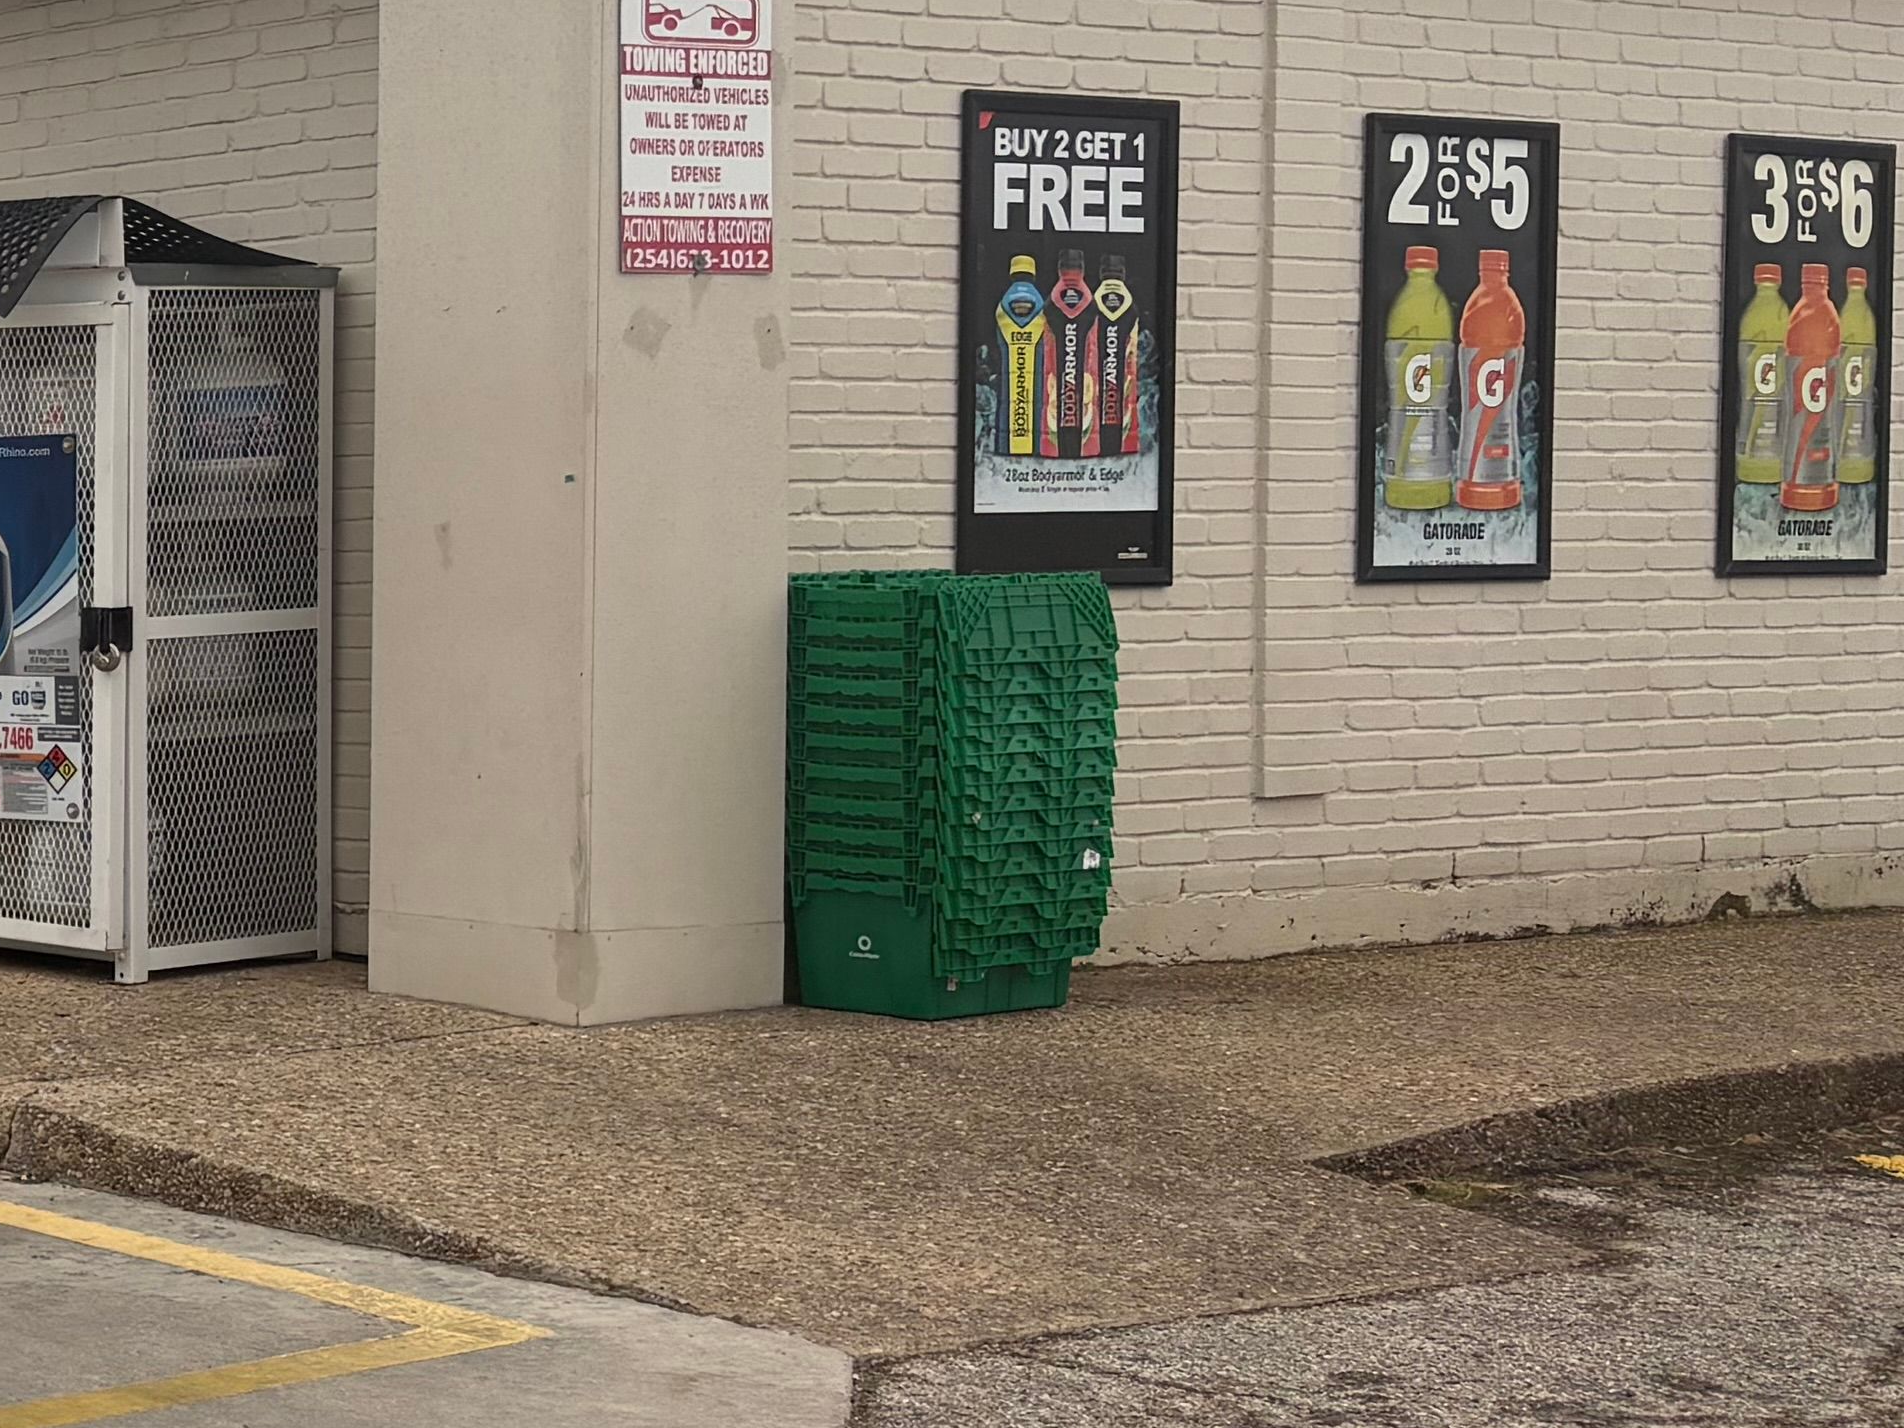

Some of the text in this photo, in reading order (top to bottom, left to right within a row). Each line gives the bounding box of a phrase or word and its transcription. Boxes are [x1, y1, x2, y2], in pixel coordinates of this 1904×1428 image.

[623, 45, 769, 77] TOWING ENFORCED
[625, 83, 769, 106] UNAUTHORIZED VEHICLES
[644, 112, 748, 132] WILL BE TOWED AT
[629, 137, 677, 156] OWNERS
[679, 139, 695, 156] OR
[994, 127, 1145, 161] BUY 2 GET 1
[671, 166, 721, 183] EXPENSE
[1387, 133, 1530, 230] 2 FOR $5
[622, 191, 769, 210] 24 HRS A DAY 7 DAYS A WK
[993, 162, 1145, 233] FREE
[1751, 153, 1875, 248] 3 FOR $6
[623, 219, 772, 245] ACTION TOWING & RECOVERY
[1063, 323, 1077, 427] BODYARMOR
[1405, 354, 1432, 403] G
[1477, 358, 1505, 408] G
[1754, 353, 1777, 394] G
[1801, 366, 1827, 413] G
[1845, 356, 1863, 396] G
[1088, 468, 1097, 481] &
[1099, 467, 1124, 484] Edge
[1423, 522, 1485, 540] GATORADE
[1778, 520, 1834, 537] GATORADE
[12, 690, 30, 706] GO
